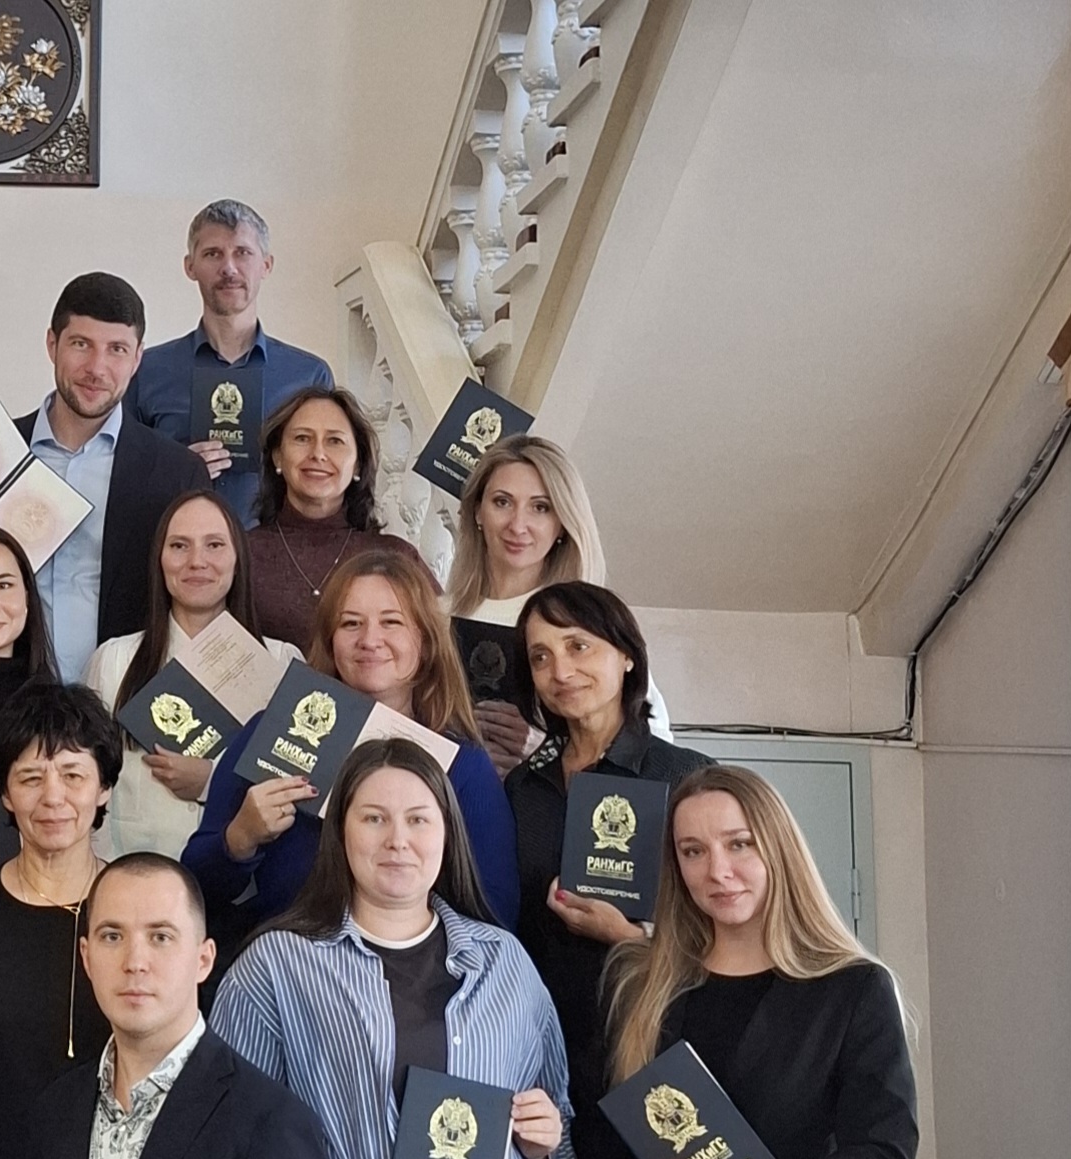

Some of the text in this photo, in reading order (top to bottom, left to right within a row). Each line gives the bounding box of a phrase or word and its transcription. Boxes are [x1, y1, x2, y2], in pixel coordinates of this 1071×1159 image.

[448, 443, 481, 467] РАНХиГ
[274, 736, 318, 766] РАНХиГС
[586, 856, 634, 873] РАНХиГС
[576, 884, 640, 900] УДОСТОВЕРЕНИЕ
